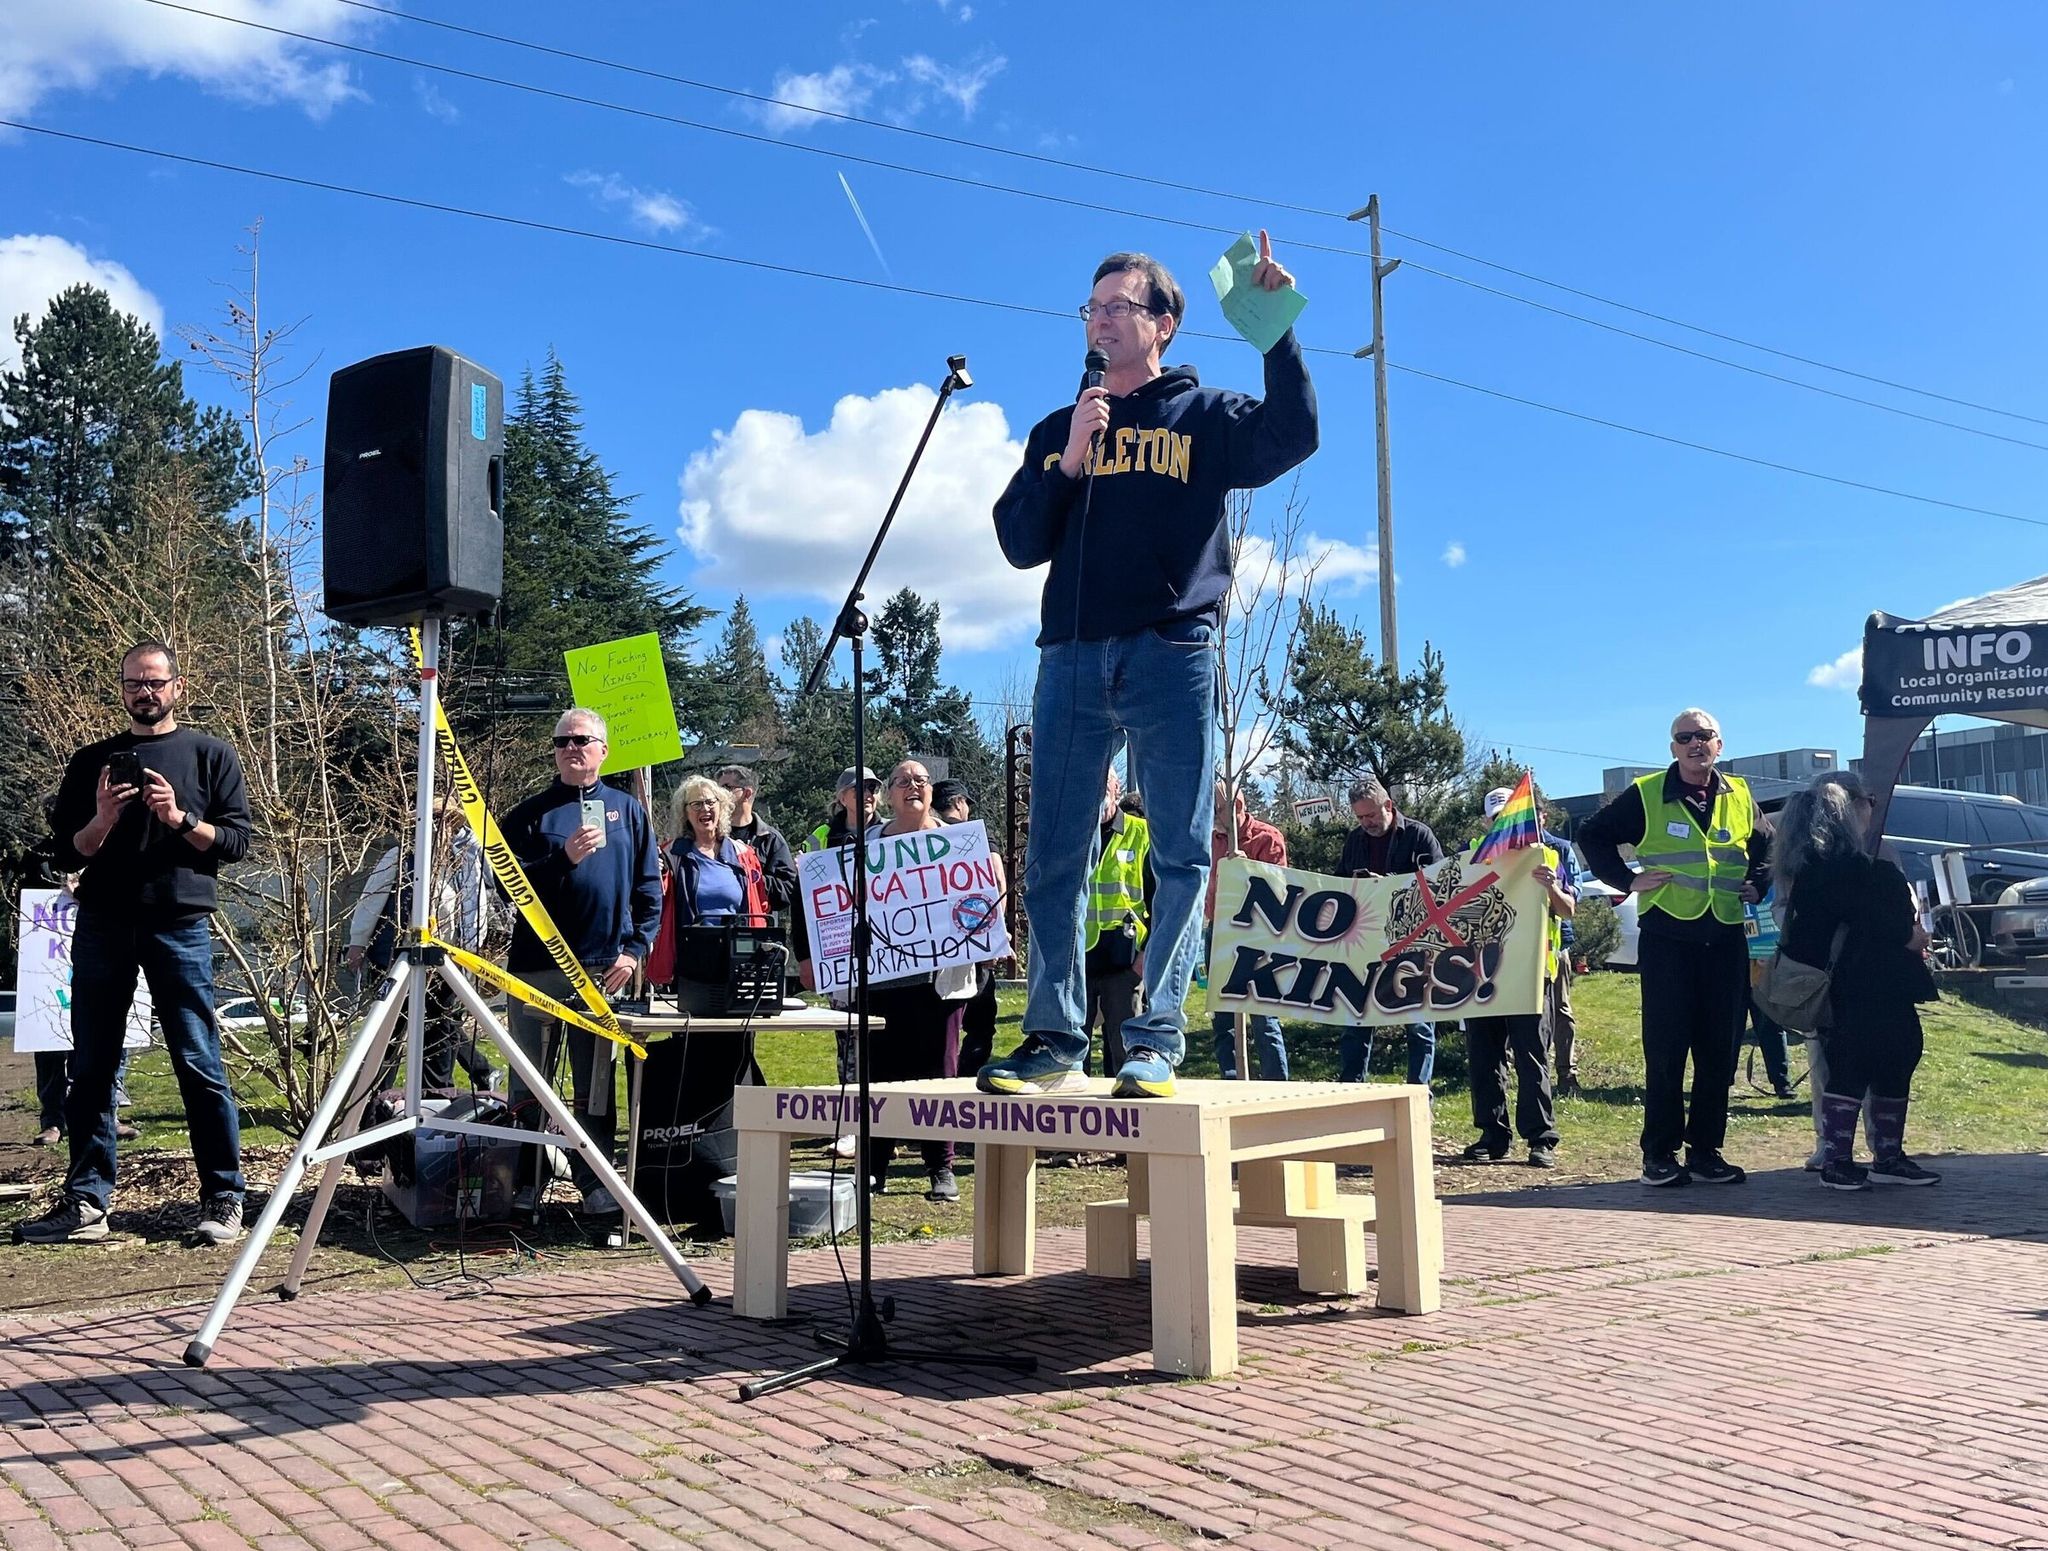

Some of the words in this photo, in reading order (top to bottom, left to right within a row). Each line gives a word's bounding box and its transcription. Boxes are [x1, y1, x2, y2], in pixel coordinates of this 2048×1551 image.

[577, 656, 598, 677] No
[608, 651, 647, 669] Fucking
[1923, 631, 2032, 671] INFO
[1891, 688, 1982, 707] Community
[1900, 673, 1941, 688] Local
[836, 833, 951, 882] FUND
[812, 858, 996, 919] EDCATION
[1230, 875, 1358, 943] NO
[867, 898, 948, 945] NOT
[1219, 942, 1504, 1018] KINGS!
[643, 1122, 706, 1142] PROEL
[909, 1097, 1141, 1138] WASHINGTON!
